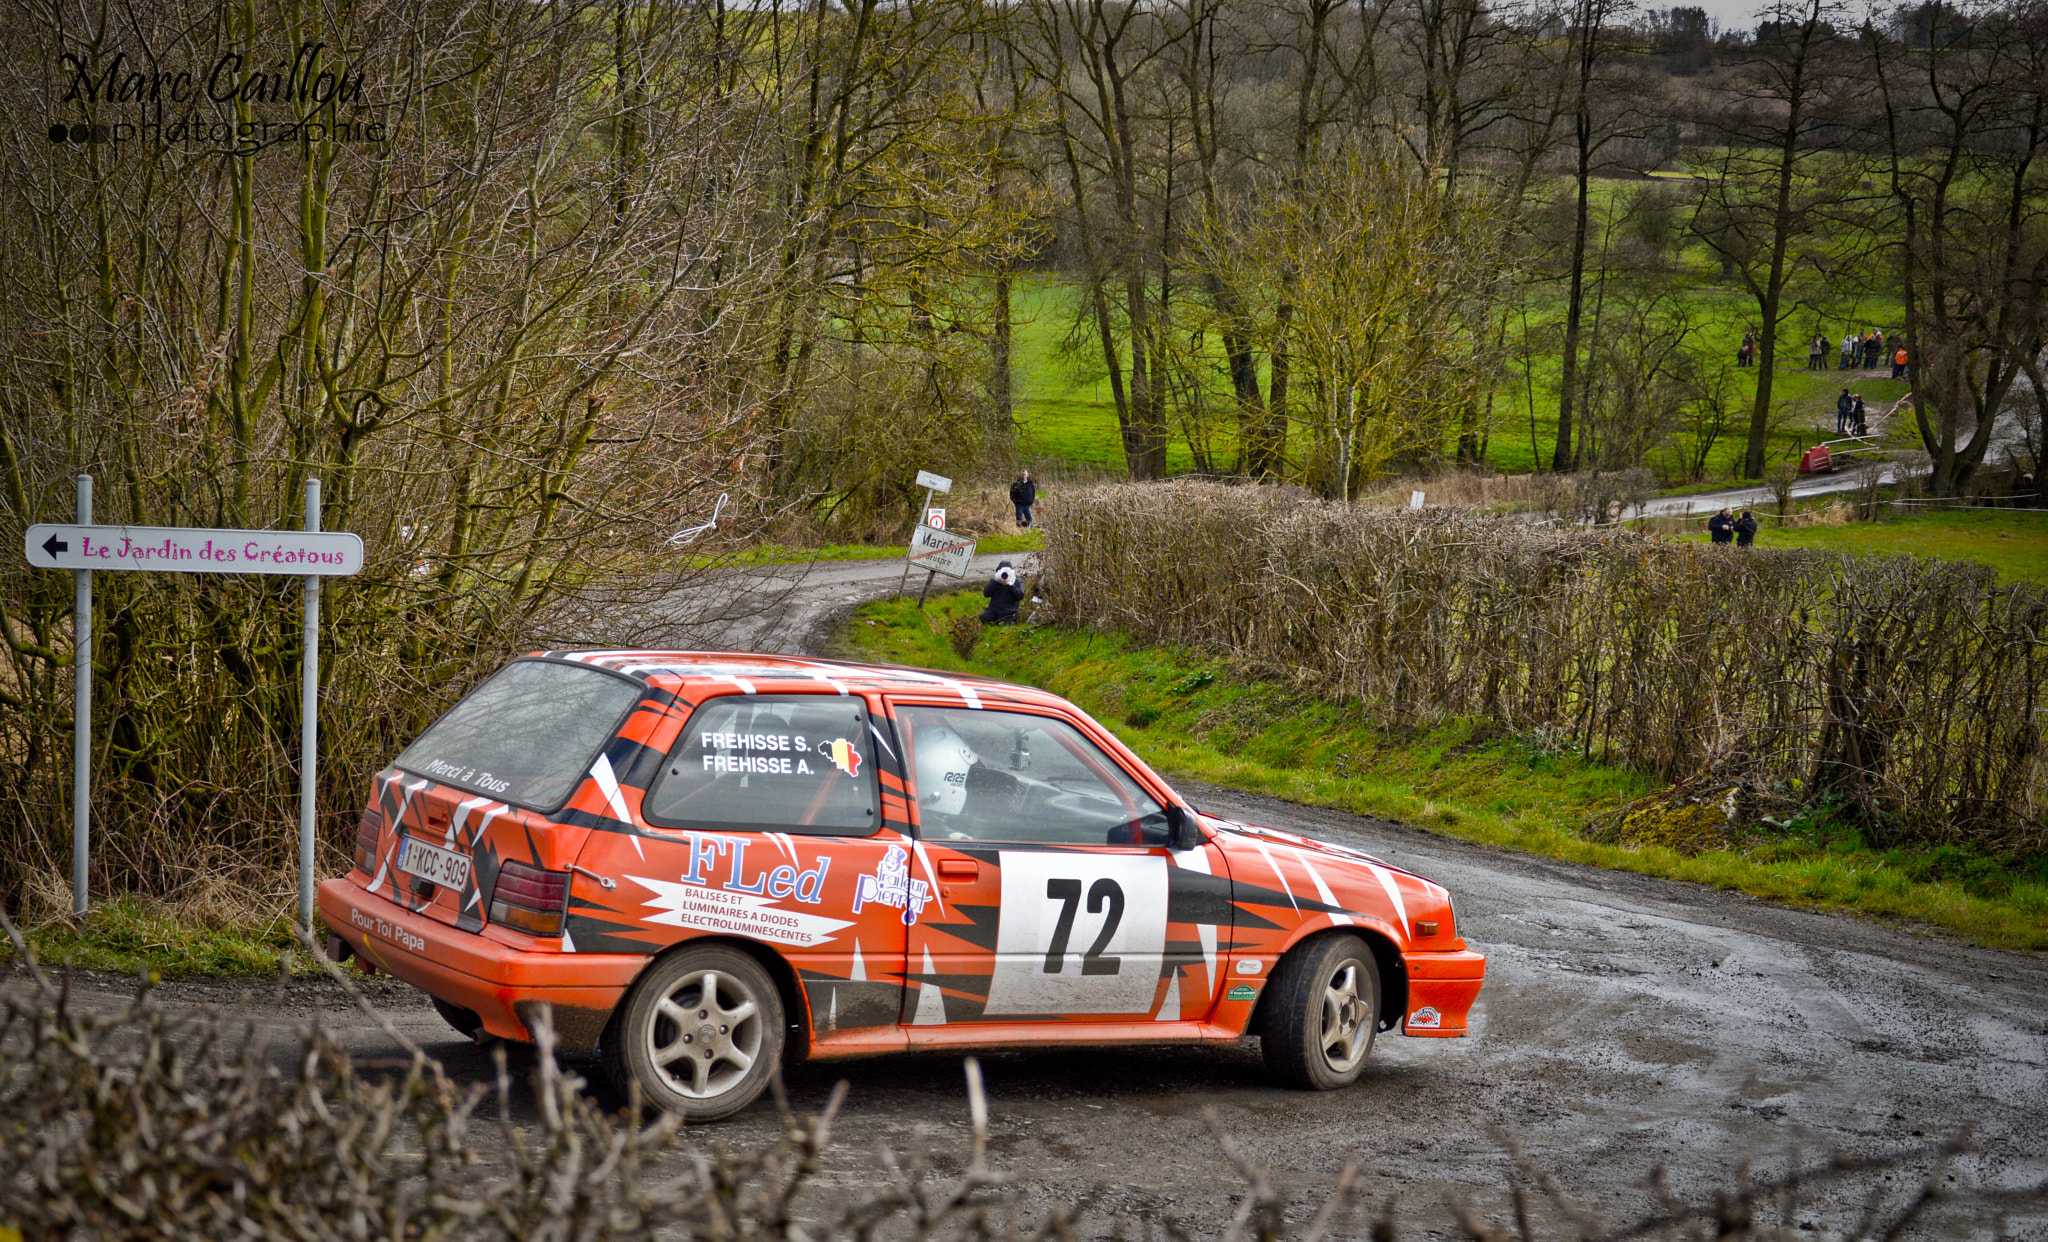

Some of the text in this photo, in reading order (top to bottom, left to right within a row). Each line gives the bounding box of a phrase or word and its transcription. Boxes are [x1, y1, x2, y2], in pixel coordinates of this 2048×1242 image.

[82, 537, 344, 565] Le Jardin des Créatous
[922, 531, 965, 557] Marchin
[701, 732, 812, 752] FREHISSE S.
[425, 758, 511, 793] Merci à Tous
[703, 755, 815, 775] FREHISSE A.
[943, 771, 966, 784] RRS
[685, 887, 743, 905] BALISES ET
[681, 913, 812, 942] ELECTROLUMINESCENTES
[682, 900, 799, 928] LUMINAIRES A DIODES
[1043, 878, 1125, 976] 72
[351, 908, 425, 952] Pour Toi Papa
